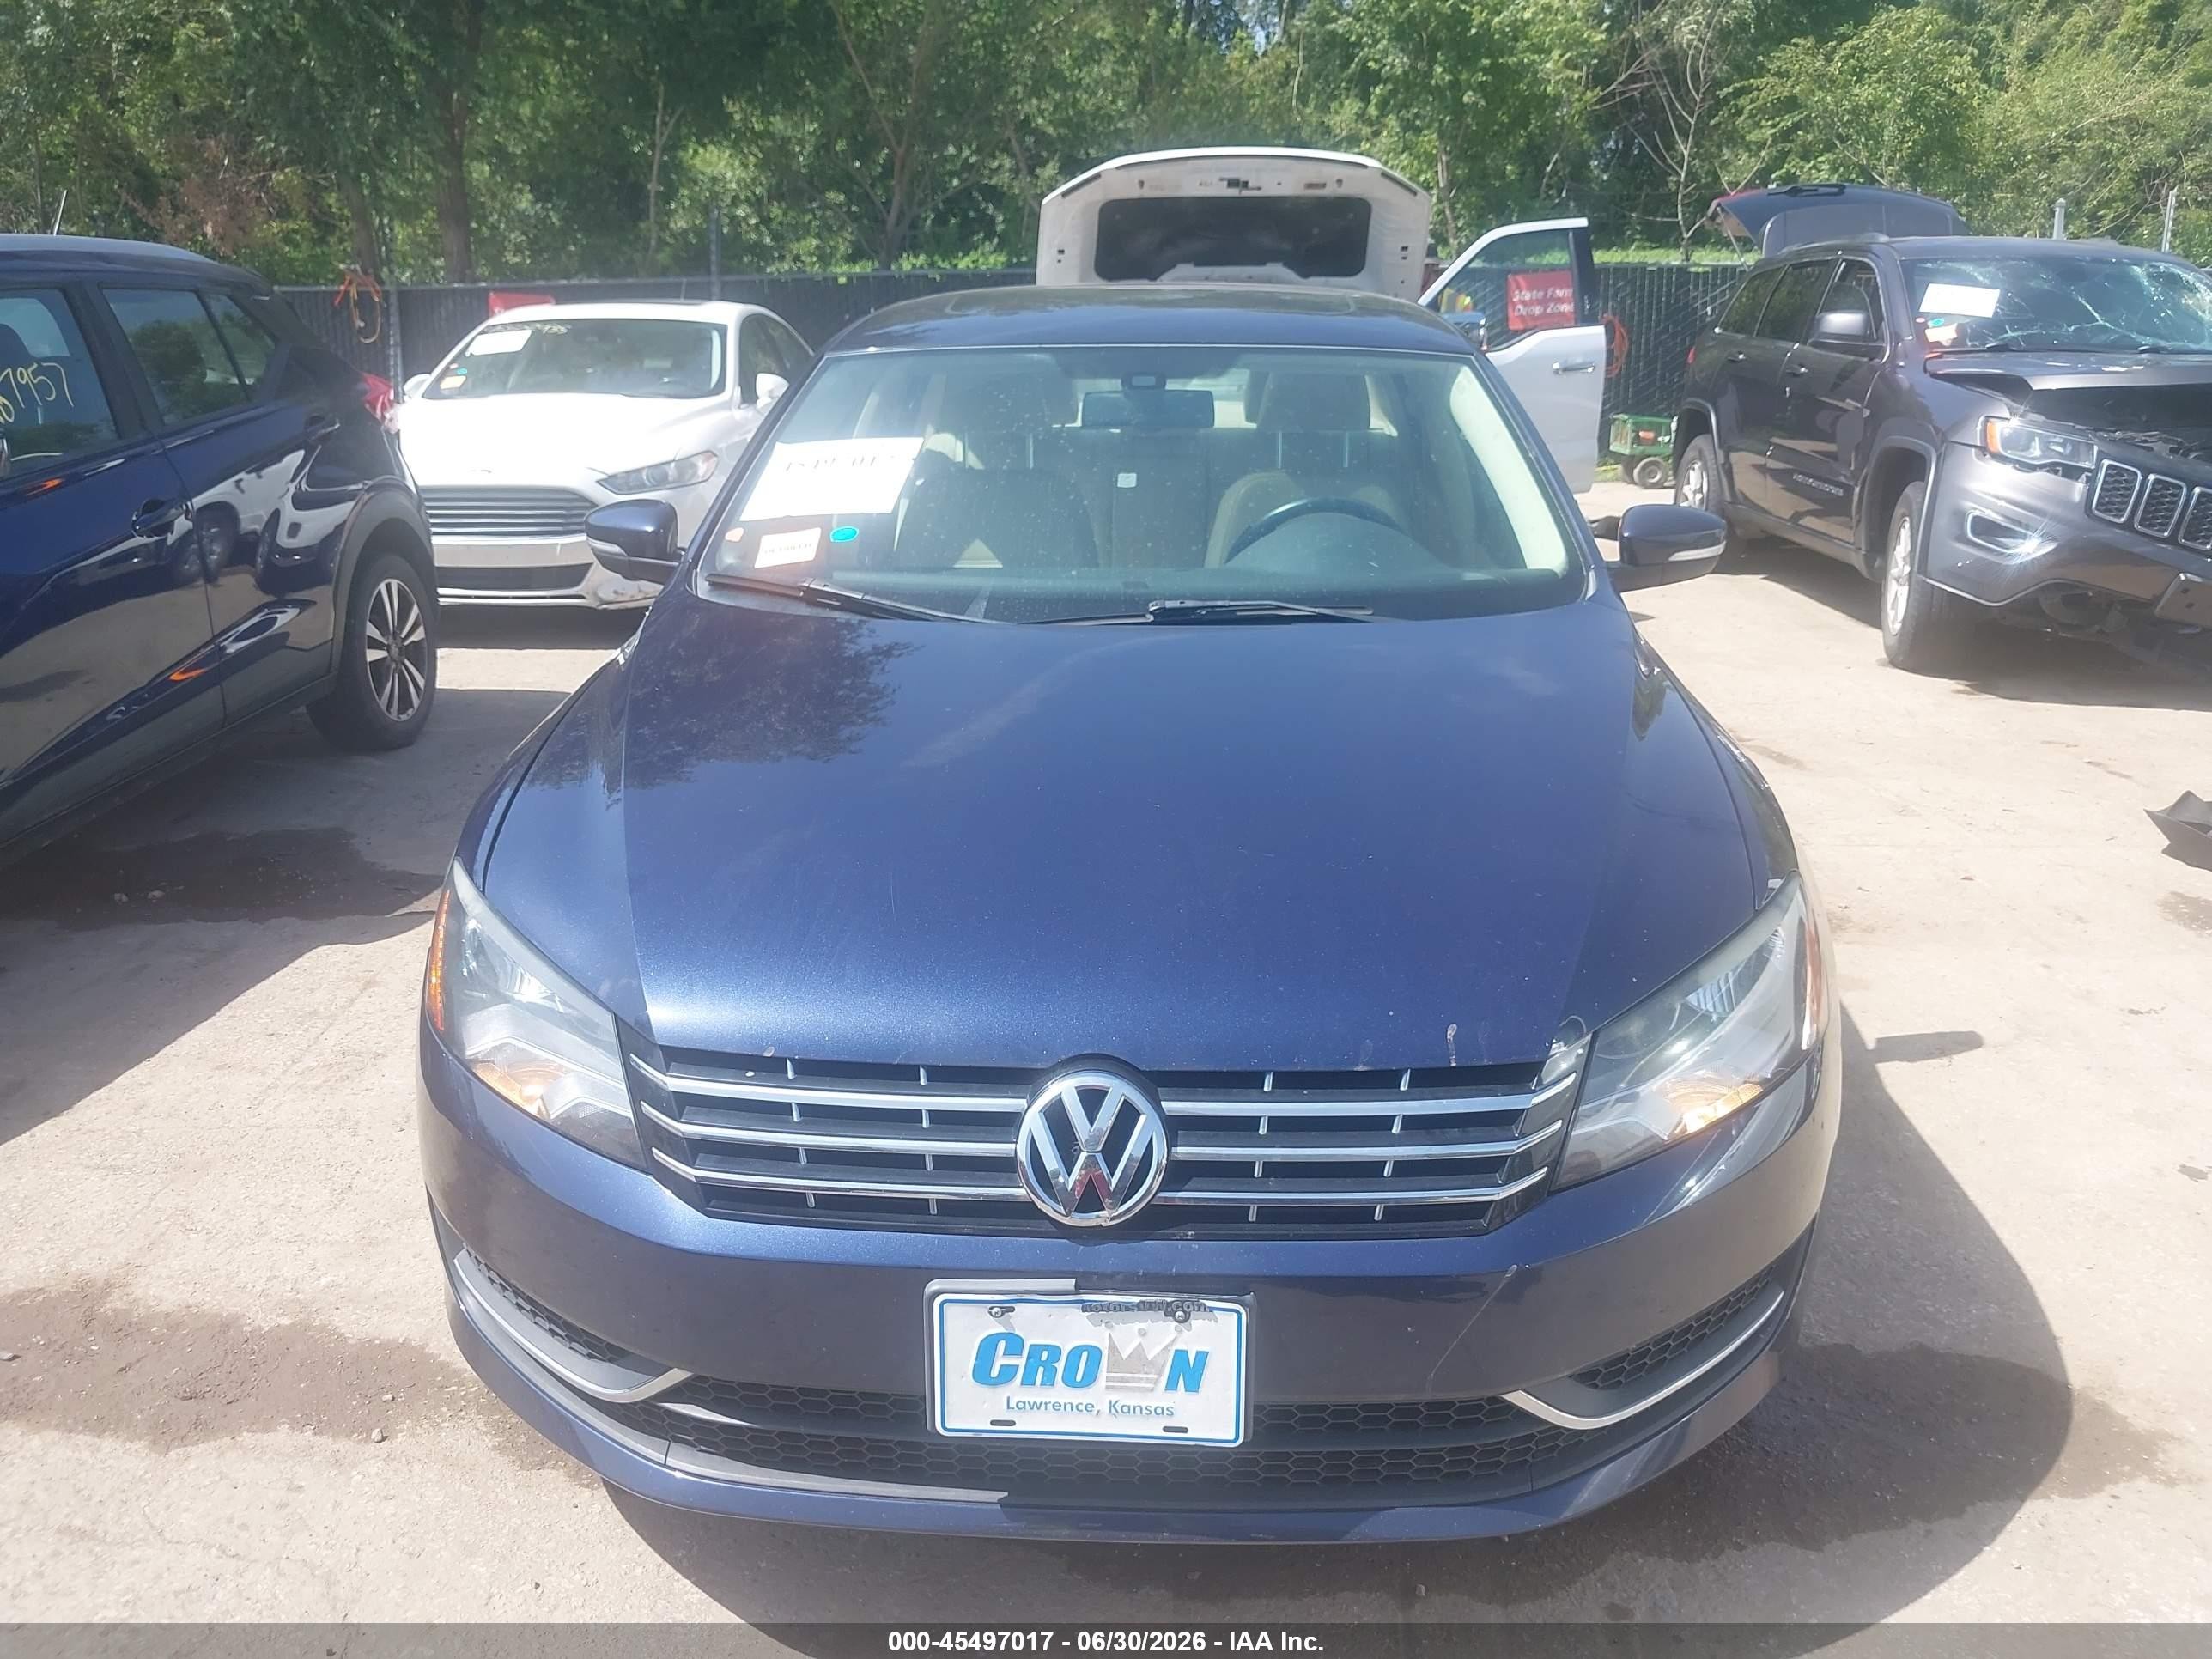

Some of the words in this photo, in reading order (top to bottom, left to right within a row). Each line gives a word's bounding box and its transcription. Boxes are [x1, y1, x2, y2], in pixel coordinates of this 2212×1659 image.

[1514, 303, 1543, 316] Drop
[1006, 1395, 1102, 1416] Lawrence,
[1108, 1399, 1176, 1417] Kansas
